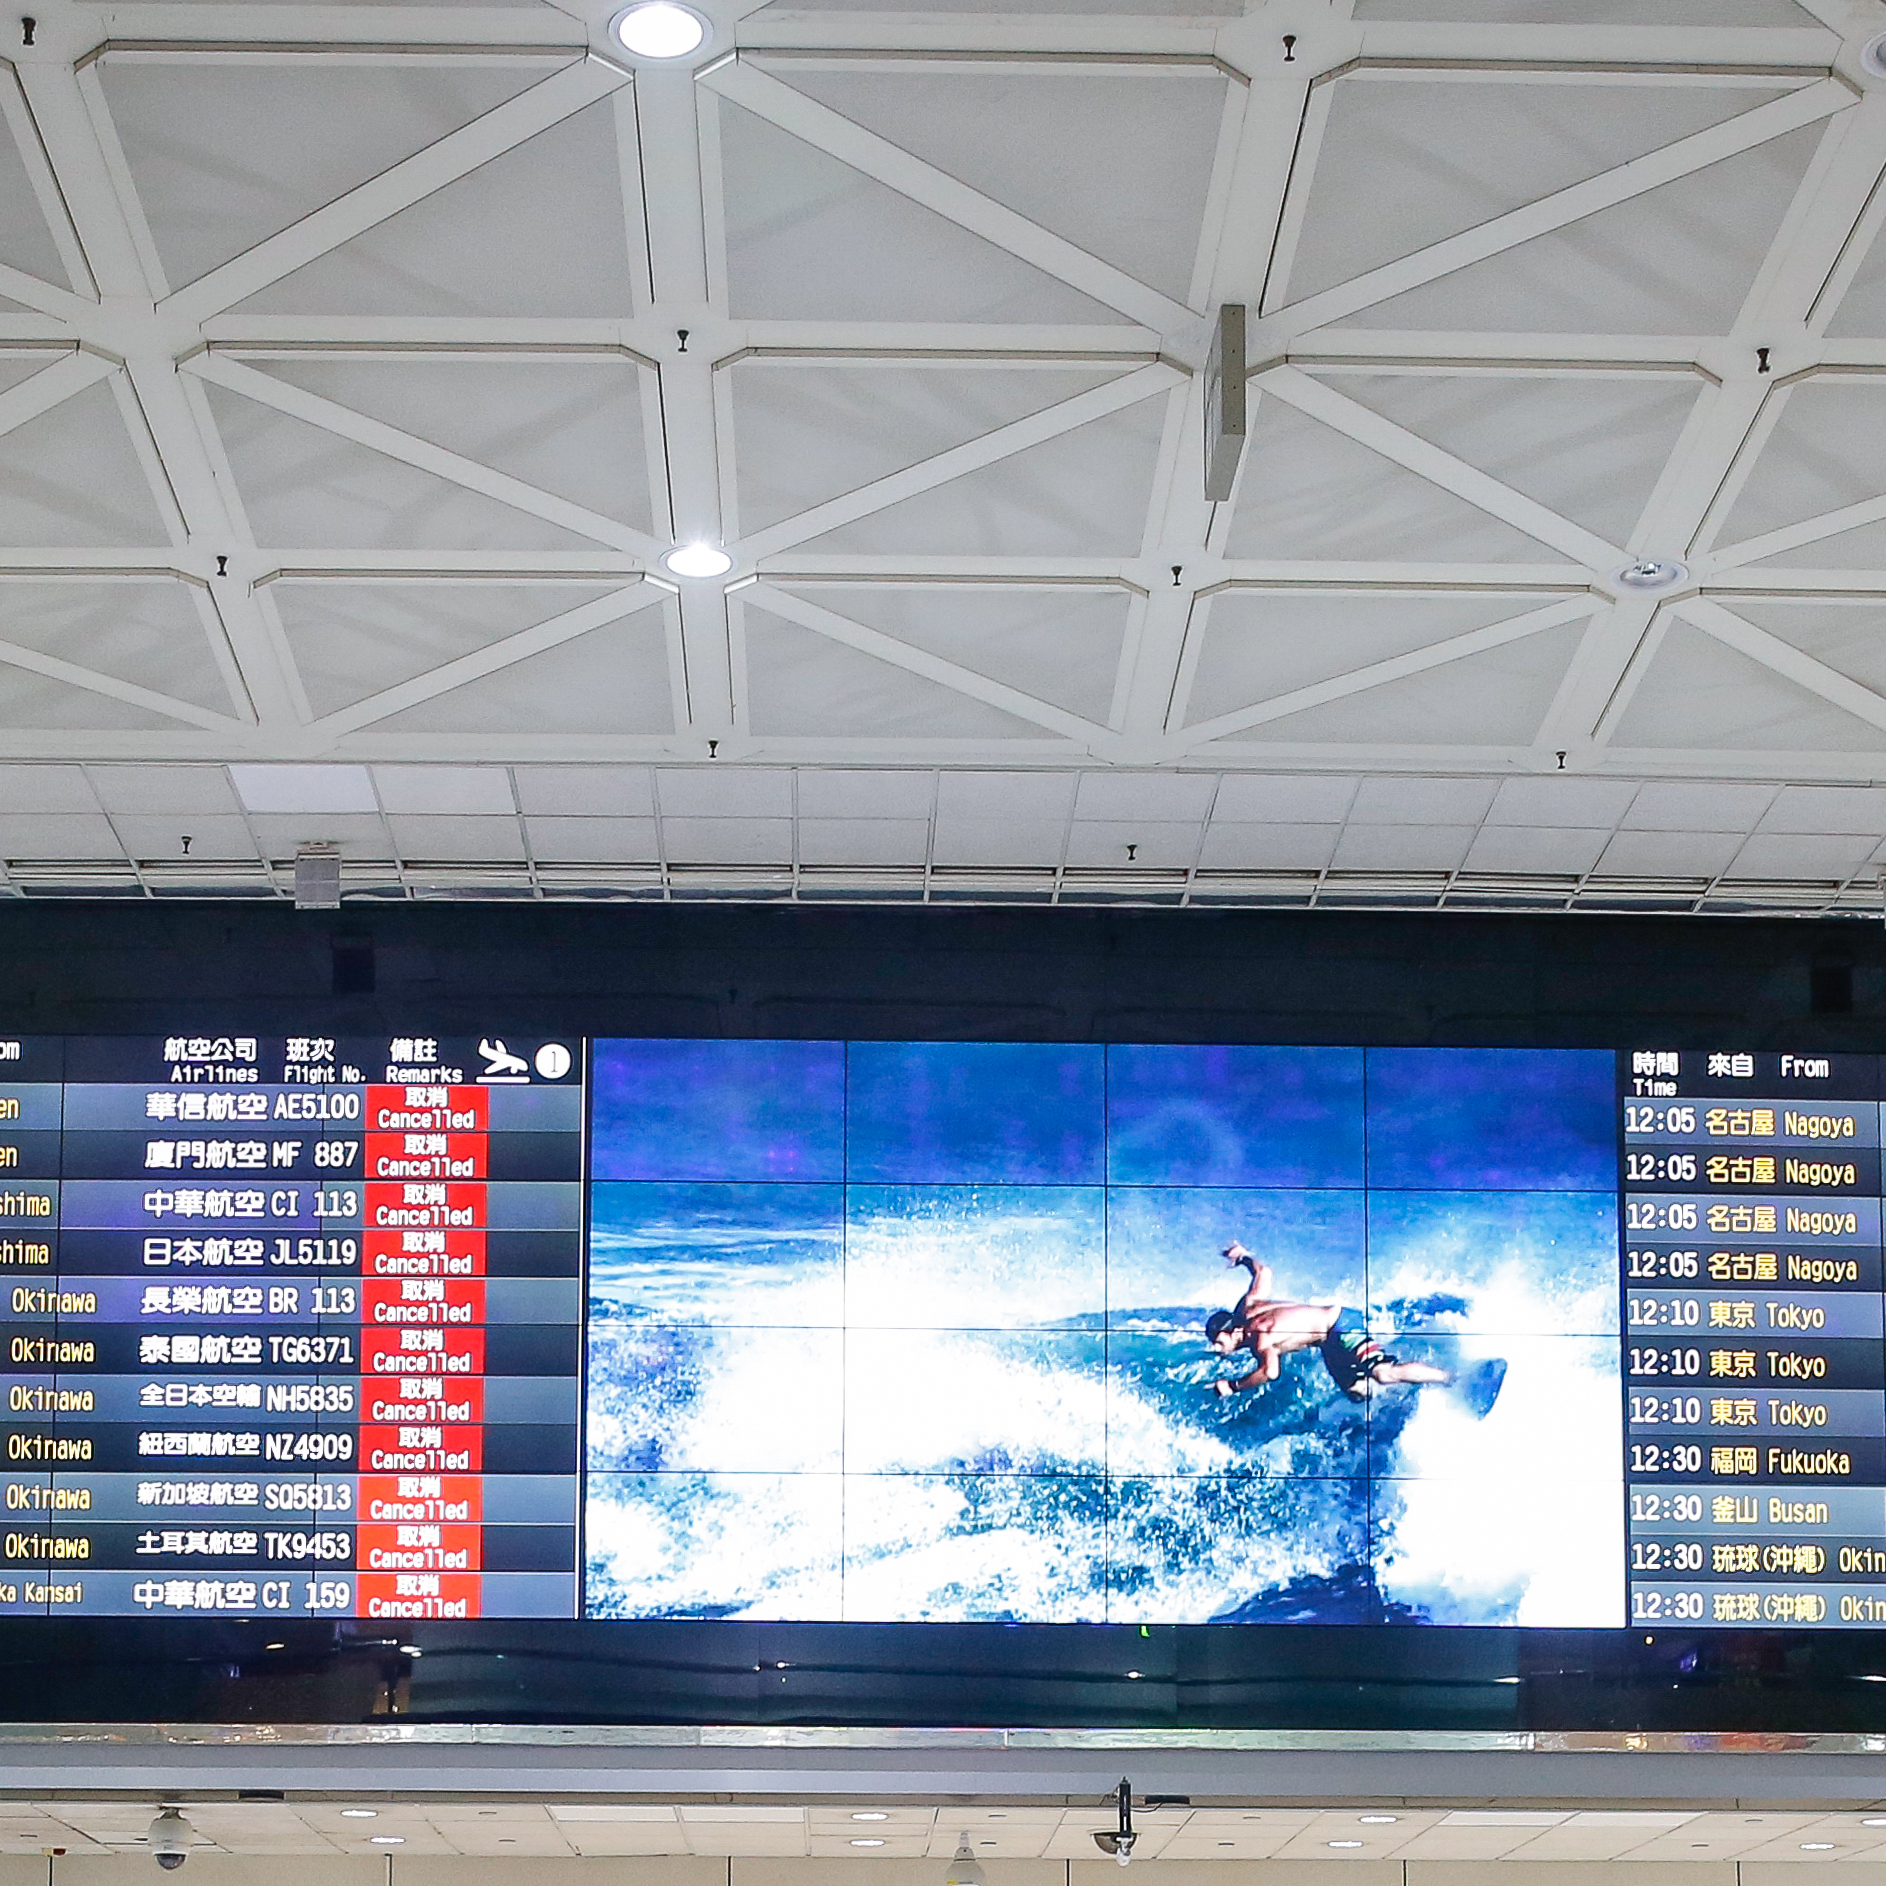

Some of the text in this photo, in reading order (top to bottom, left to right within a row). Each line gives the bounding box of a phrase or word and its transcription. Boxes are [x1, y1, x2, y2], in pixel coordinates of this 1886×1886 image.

[163, 1037, 257, 1062] 航空公司
[286, 1037, 335, 1062] 班次
[389, 1037, 437, 1063] 備註
[170, 1064, 258, 1083] Airlines
[284, 1065, 366, 1087] Flight No.
[386, 1065, 463, 1083] Remarks
[1633, 1050, 1829, 1078] 時間 來自 From
[405, 1086, 448, 1108] 取消
[1630, 1078, 1677, 1100] Time
[146, 1092, 268, 1121] 華信航空
[273, 1093, 359, 1119] AE5100
[378, 1105, 475, 1129] Cancelled
[1625, 1106, 1696, 1133] 12:05
[1705, 1108, 1854, 1139] 名古屋 Nagoya
[144, 1189, 265, 1218] 中華航空
[271, 1190, 357, 1217] CI 113
[403, 1183, 446, 1205] 取消
[376, 1202, 473, 1226] Cancelled
[1627, 1203, 1697, 1230] 12:05
[1706, 1205, 1856, 1235] 名古屋 Nagoya
[11, 1337, 94, 1362] Okinawa
[139, 1334, 262, 1364] 泰國航空
[268, 1336, 354, 1363] TG6371
[400, 1328, 444, 1351] 取消
[373, 1348, 470, 1373] Cancelled
[1629, 1396, 1701, 1424] 12:10
[1710, 1397, 1827, 1428] 東京 Tokyo
[8, 1434, 92, 1460] Okinawa
[138, 1431, 260, 1456] 紐西蘭航空
[265, 1433, 353, 1461] NZ4909
[398, 1426, 442, 1449] 取消
[371, 1445, 469, 1470] Cancelled
[1631, 1445, 1702, 1472] 12:30
[1710, 1447, 1850, 1475] 福岡 Fukuoka
[24, 1581, 82, 1603] Kansai
[133, 1579, 257, 1609] 中華航空
[262, 1579, 350, 1609] CI 159
[395, 1572, 440, 1596] 取消
[368, 1592, 467, 1618] Cancelled
